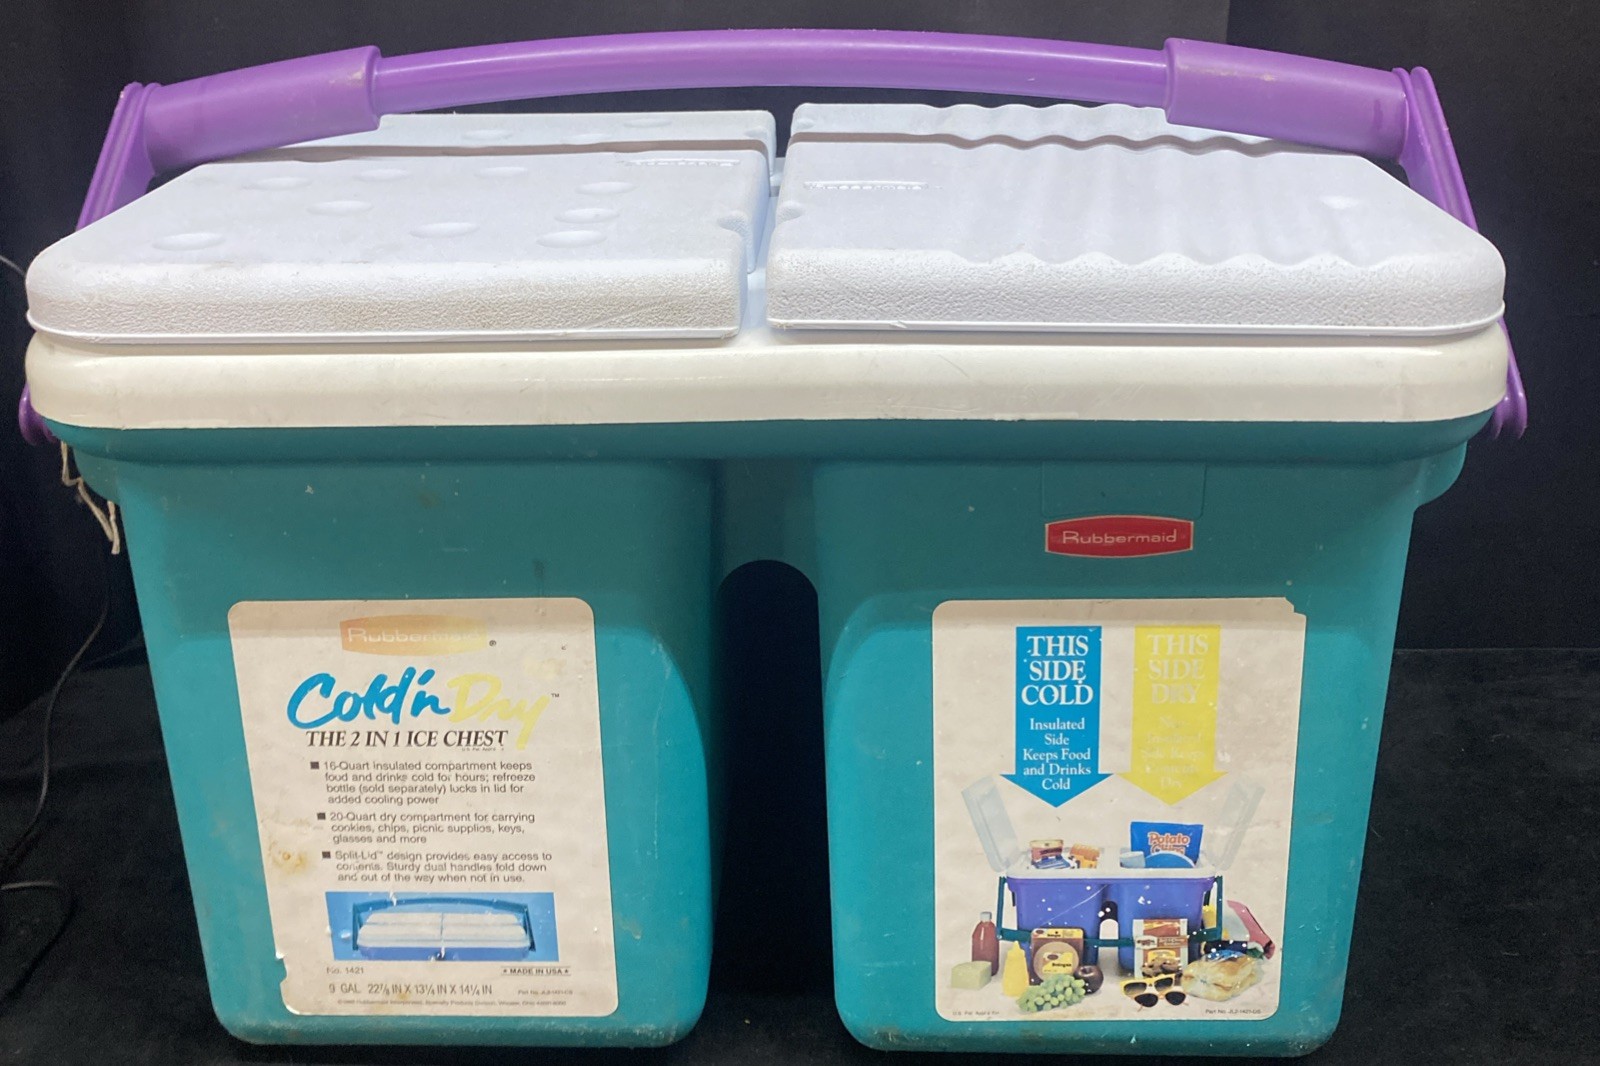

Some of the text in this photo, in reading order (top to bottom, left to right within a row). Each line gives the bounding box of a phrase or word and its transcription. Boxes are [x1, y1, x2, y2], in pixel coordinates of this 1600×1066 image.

[1062, 528, 1178, 544] Rubbermaid
[1026, 635, 1089, 657] THIS
[1147, 634, 1209, 656] THIS
[1029, 660, 1087, 682] SIDE
[1148, 658, 1205, 681] SIDE
[1021, 684, 1094, 706] COLD
[1151, 683, 1202, 705] DRY
[1029, 717, 1086, 731] Insulated
[305, 729, 509, 748] THE 2 IN 1 ICE CHEST
[1044, 732, 1070, 746] Side
[1022, 747, 1091, 763] Keeps Food
[324, 761, 533, 773] 16-Quart insulated compartment keeps
[1023, 763, 1092, 776] and Drinks
[325, 772, 348, 782] food
[351, 772, 373, 782] and
[375, 772, 408, 782] drinks
[411, 772, 435, 782] cold
[455, 772, 489, 783] hours;
[492, 772, 536, 782] refreeze
[1041, 777, 1071, 791] Cold
[326, 783, 356, 793] bottle
[359, 783, 385, 795] (sold
[388, 783, 447, 795] separately)
[480, 783, 491, 793] in
[493, 783, 507, 793] lid
[510, 783, 524, 793] for
[328, 794, 439, 806] added cooling power
[330, 811, 536, 824] 20-Quart dry compartment for carrying
[331, 823, 526, 835] cookies, chips, picnic supplies, keys,
[332, 834, 427, 845] glasses and more
[1148, 832, 1190, 846] Potato
[386, 851, 422, 862] design
[425, 851, 470, 863] provides
[473, 852, 499, 863] easy
[501, 853, 539, 861] access
[542, 852, 553, 861] to
[386, 862, 420, 873] Sturdy
[424, 862, 447, 872] dual
[450, 862, 493, 872] handles
[495, 862, 515, 872] fold
[518, 862, 547, 872] down
[360, 873, 378, 882] out
[380, 872, 391, 882] of
[394, 873, 411, 882] the
[414, 875, 435, 884] way
[438, 874, 470, 883] when
[470, 874, 487, 883] not
[490, 874, 500, 883] in
[503, 875, 525, 883] use.
[345, 966, 365, 975] 1421
[509, 967, 563, 975] MADE IN USA
[328, 983, 336, 994] 9
[340, 983, 361, 994] GAL
[391, 984, 402, 995] IN
[404, 984, 413, 994] X
[436, 984, 448, 995] IN
[449, 984, 458, 995] X
[482, 984, 493, 995] IN
